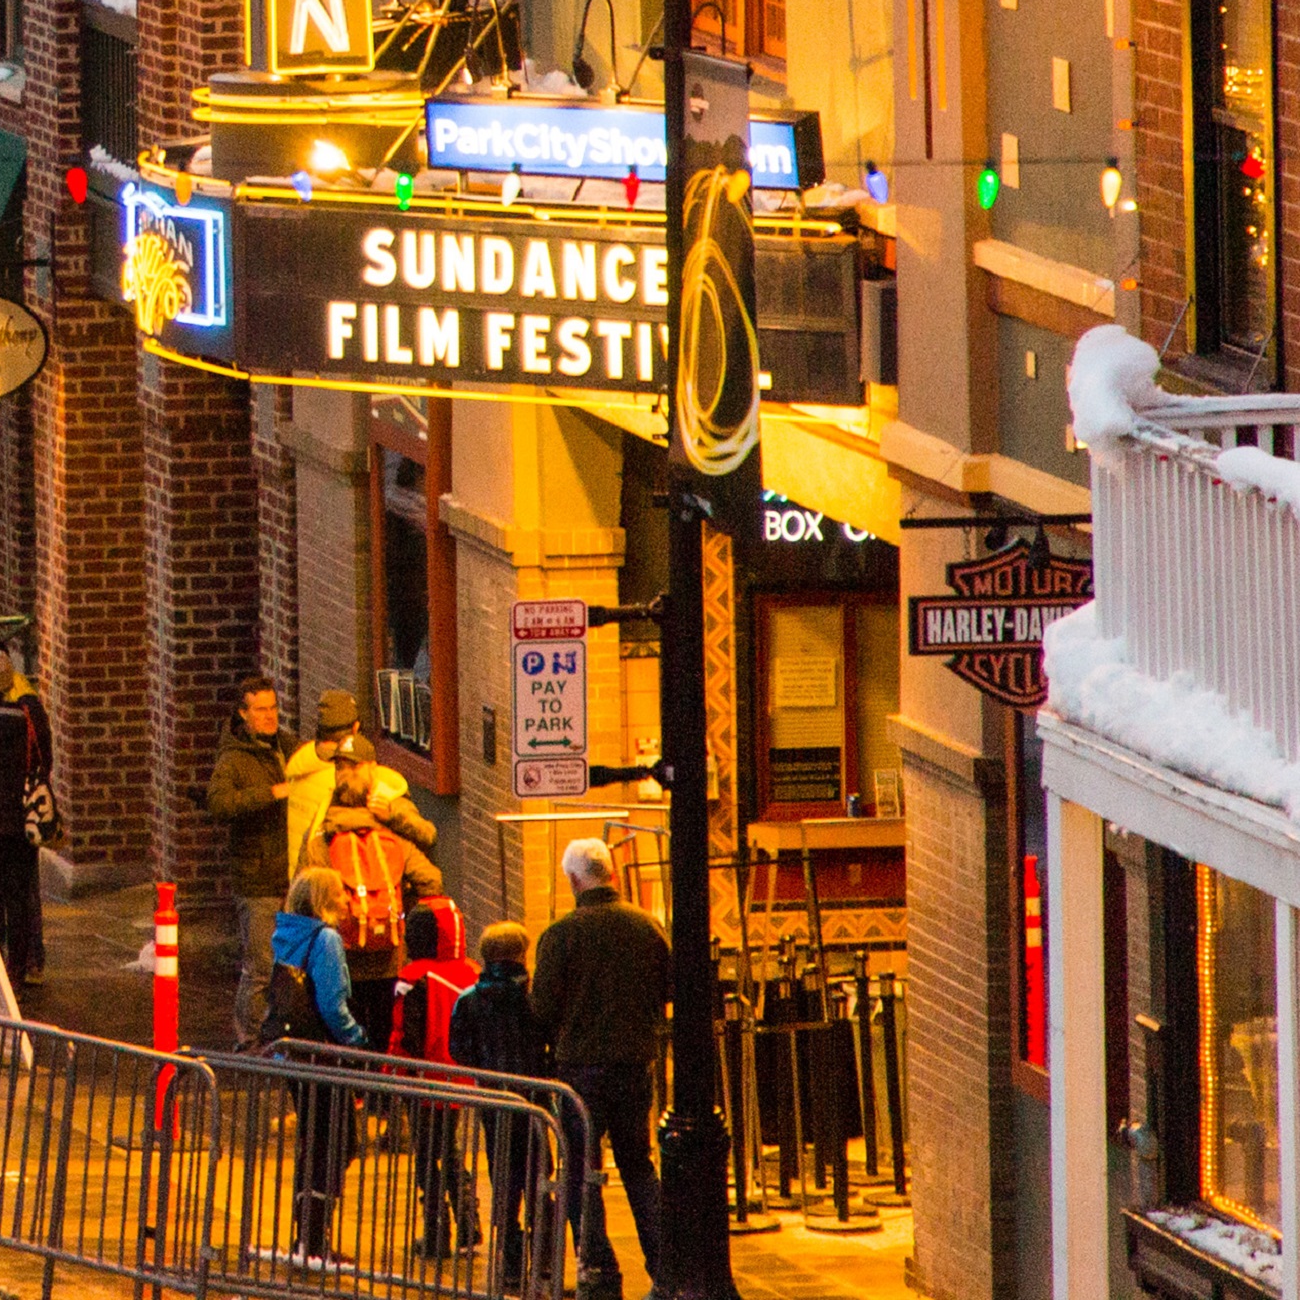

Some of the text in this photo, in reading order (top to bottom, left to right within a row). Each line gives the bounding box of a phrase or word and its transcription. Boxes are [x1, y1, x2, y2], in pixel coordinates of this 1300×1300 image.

[362, 228, 668, 307] SUNDANCE
[326, 300, 461, 369] FILM
[764, 509, 824, 542] BOX
[972, 558, 1073, 597] MOTOR
[531, 680, 567, 695] PAY
[973, 652, 1046, 694] CYCL
[525, 717, 574, 732] PARK
[538, 699, 562, 714] TO
